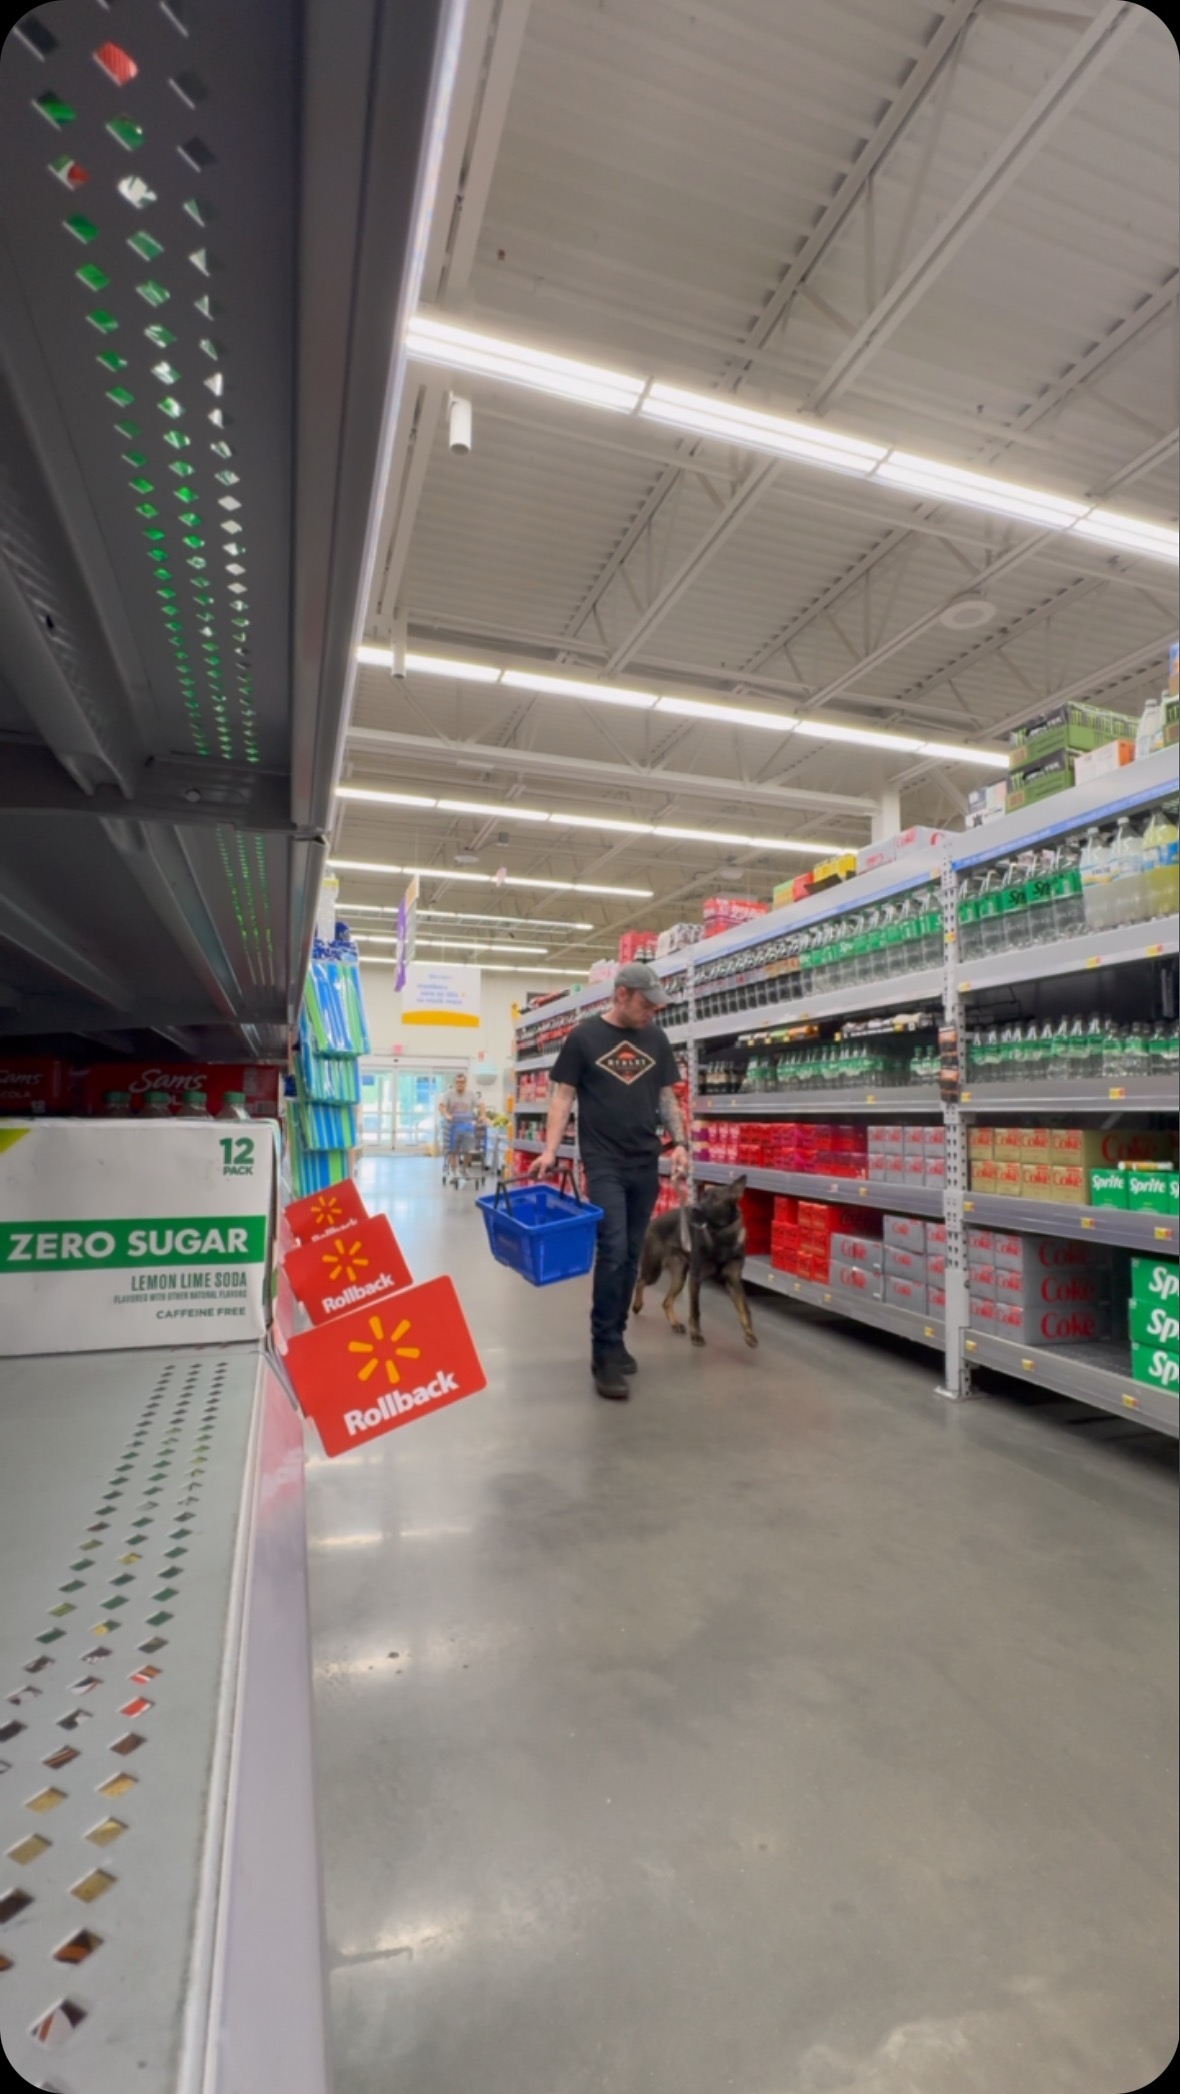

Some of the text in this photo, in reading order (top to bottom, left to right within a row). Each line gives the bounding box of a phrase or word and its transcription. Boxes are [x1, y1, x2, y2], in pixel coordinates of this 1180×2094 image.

[219, 1137, 255, 1165] 12
[223, 1166, 253, 1176] PACK
[1092, 1174, 1124, 1192] Sprite
[1129, 1177, 1166, 1196] Sprite
[7, 1228, 249, 1261] ZERO SUGAR
[131, 1271, 247, 1291] LEMON LIME SODA
[321, 1272, 395, 1314] Rollback
[1041, 1275, 1096, 1304] Coke
[156, 1306, 246, 1320] CAFFEINE FREE
[1041, 1311, 1096, 1341] Coke
[343, 1370, 460, 1437] Rollback
